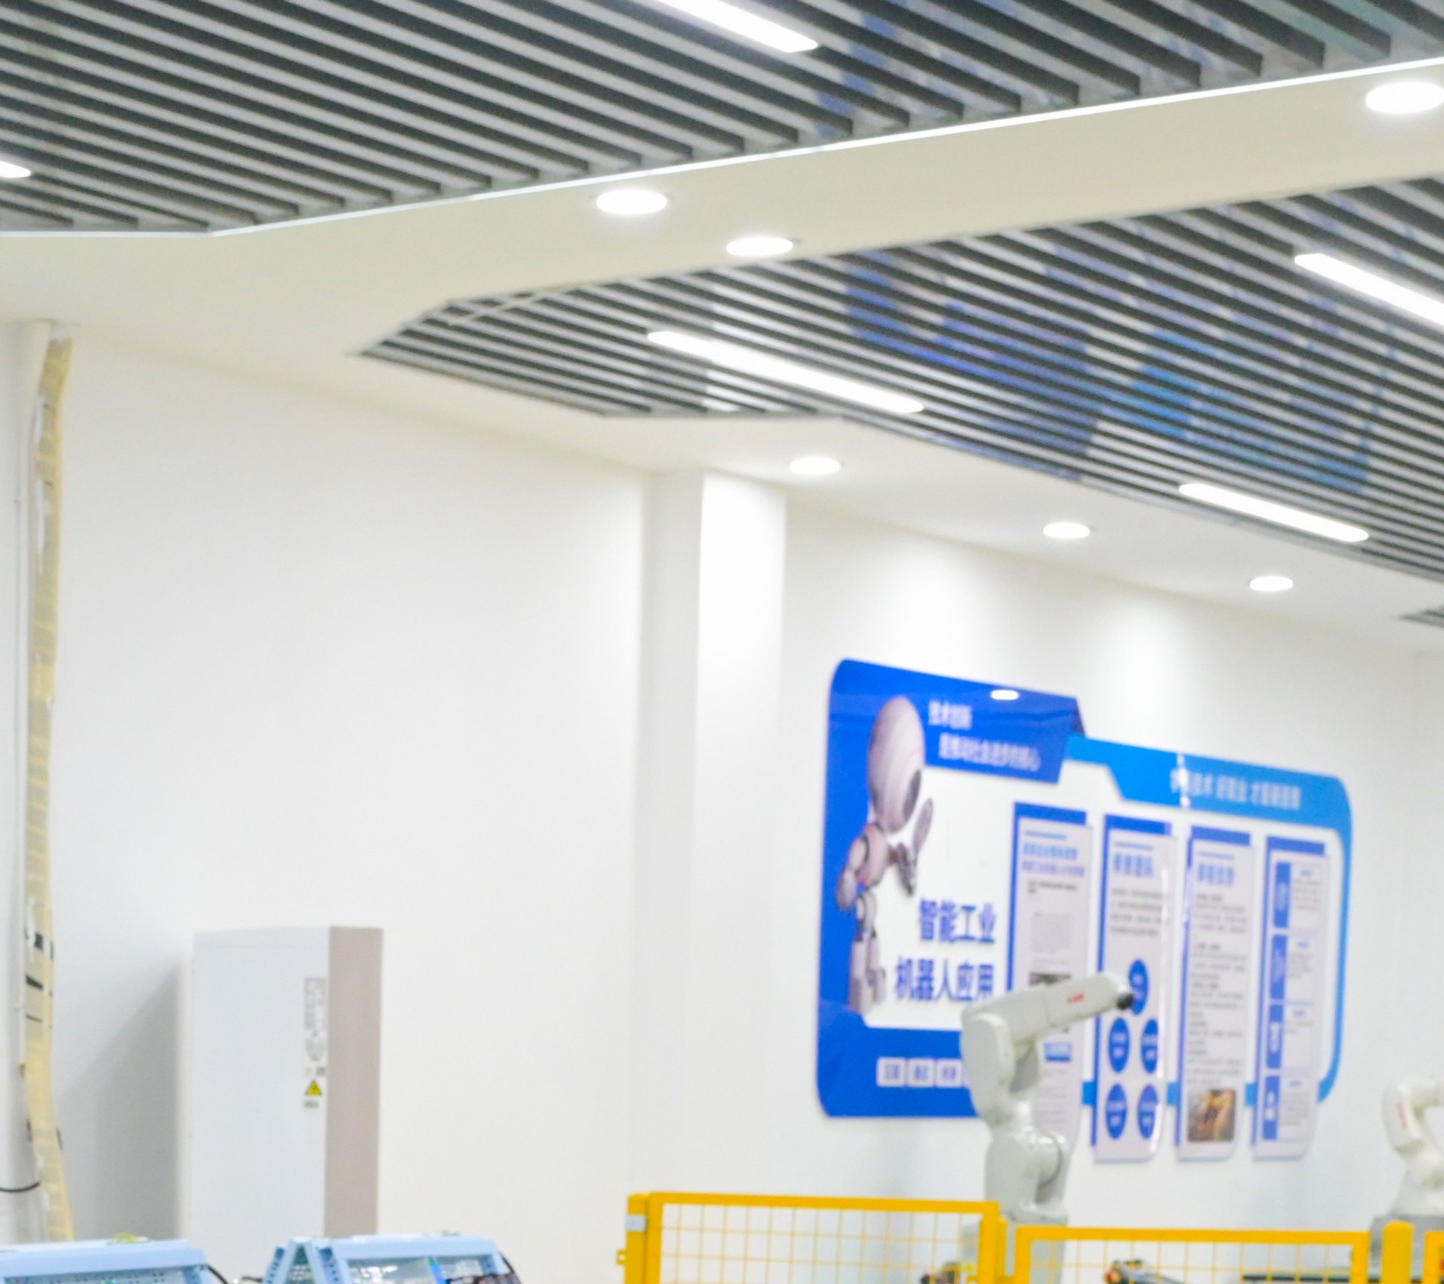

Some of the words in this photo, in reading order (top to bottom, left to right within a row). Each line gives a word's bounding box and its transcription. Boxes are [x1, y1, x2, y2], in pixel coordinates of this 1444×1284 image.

[919, 898, 996, 943] 智能工业
[895, 956, 994, 1002] 机器人应用
